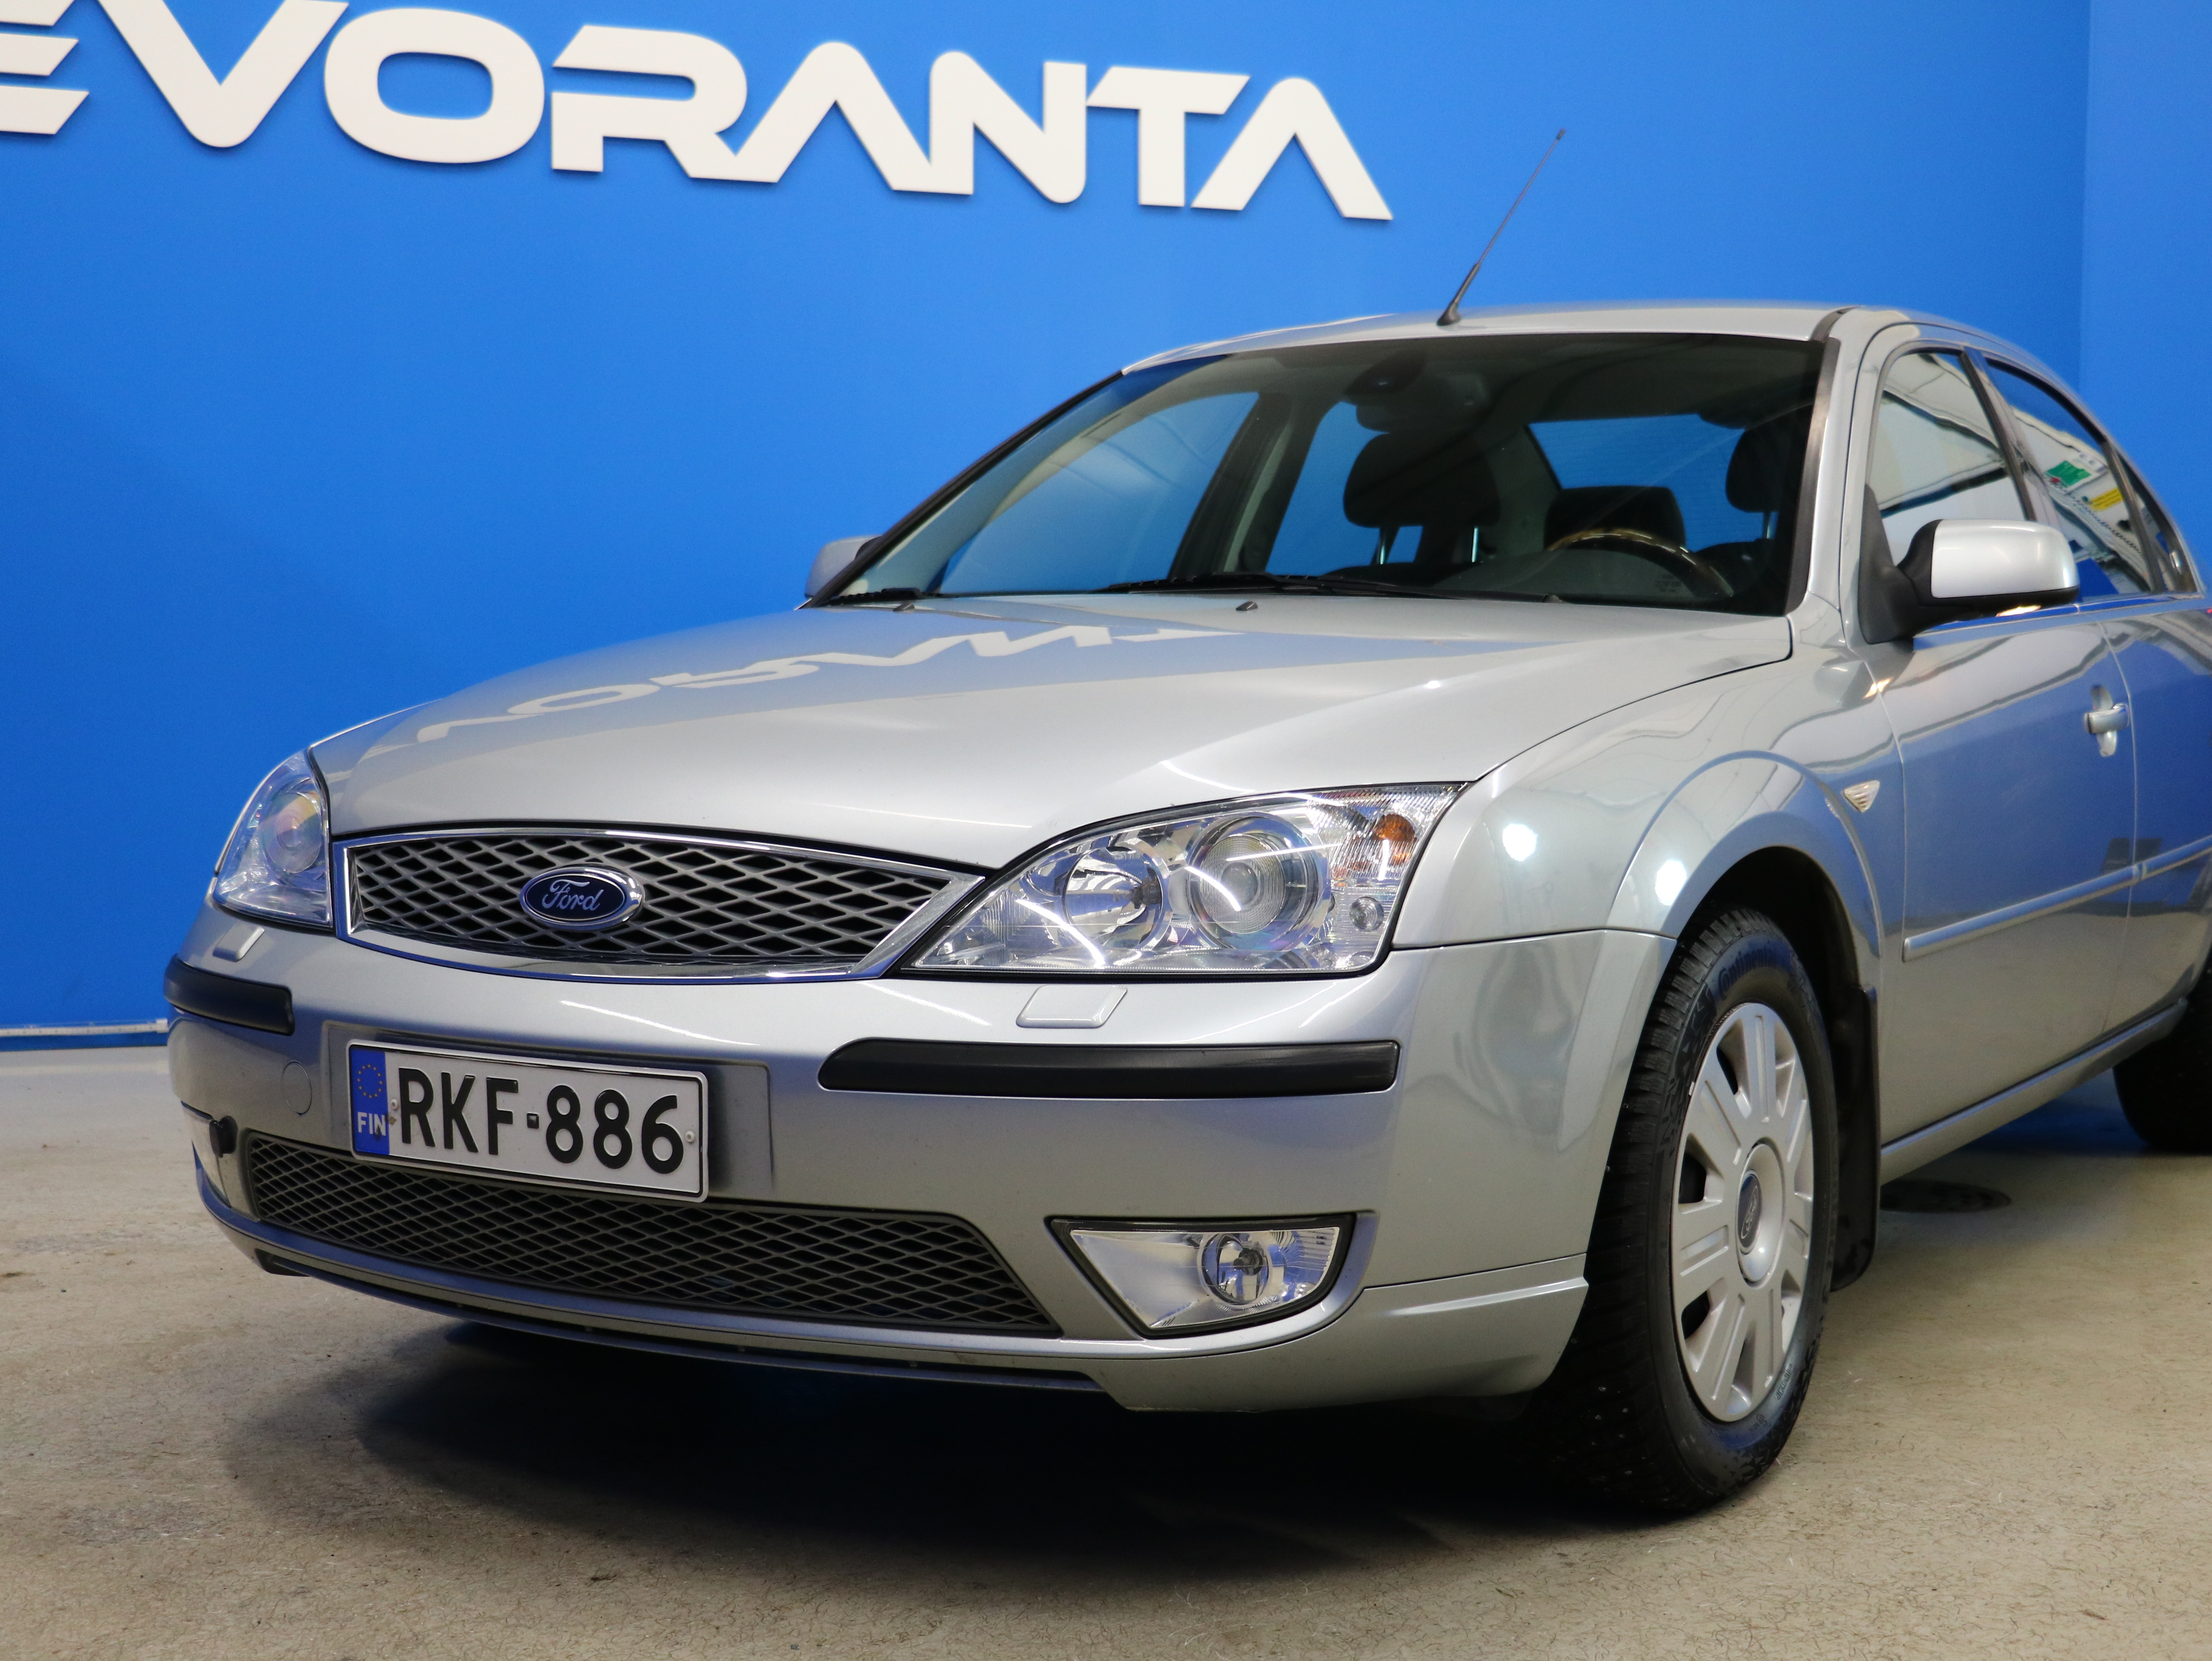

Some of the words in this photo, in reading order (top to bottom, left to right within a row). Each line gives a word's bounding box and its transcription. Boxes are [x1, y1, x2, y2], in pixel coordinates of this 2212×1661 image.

[542, 879, 604, 911] Ford
[357, 1112, 386, 1136] FIN
[399, 1067, 684, 1174] RKF-886
